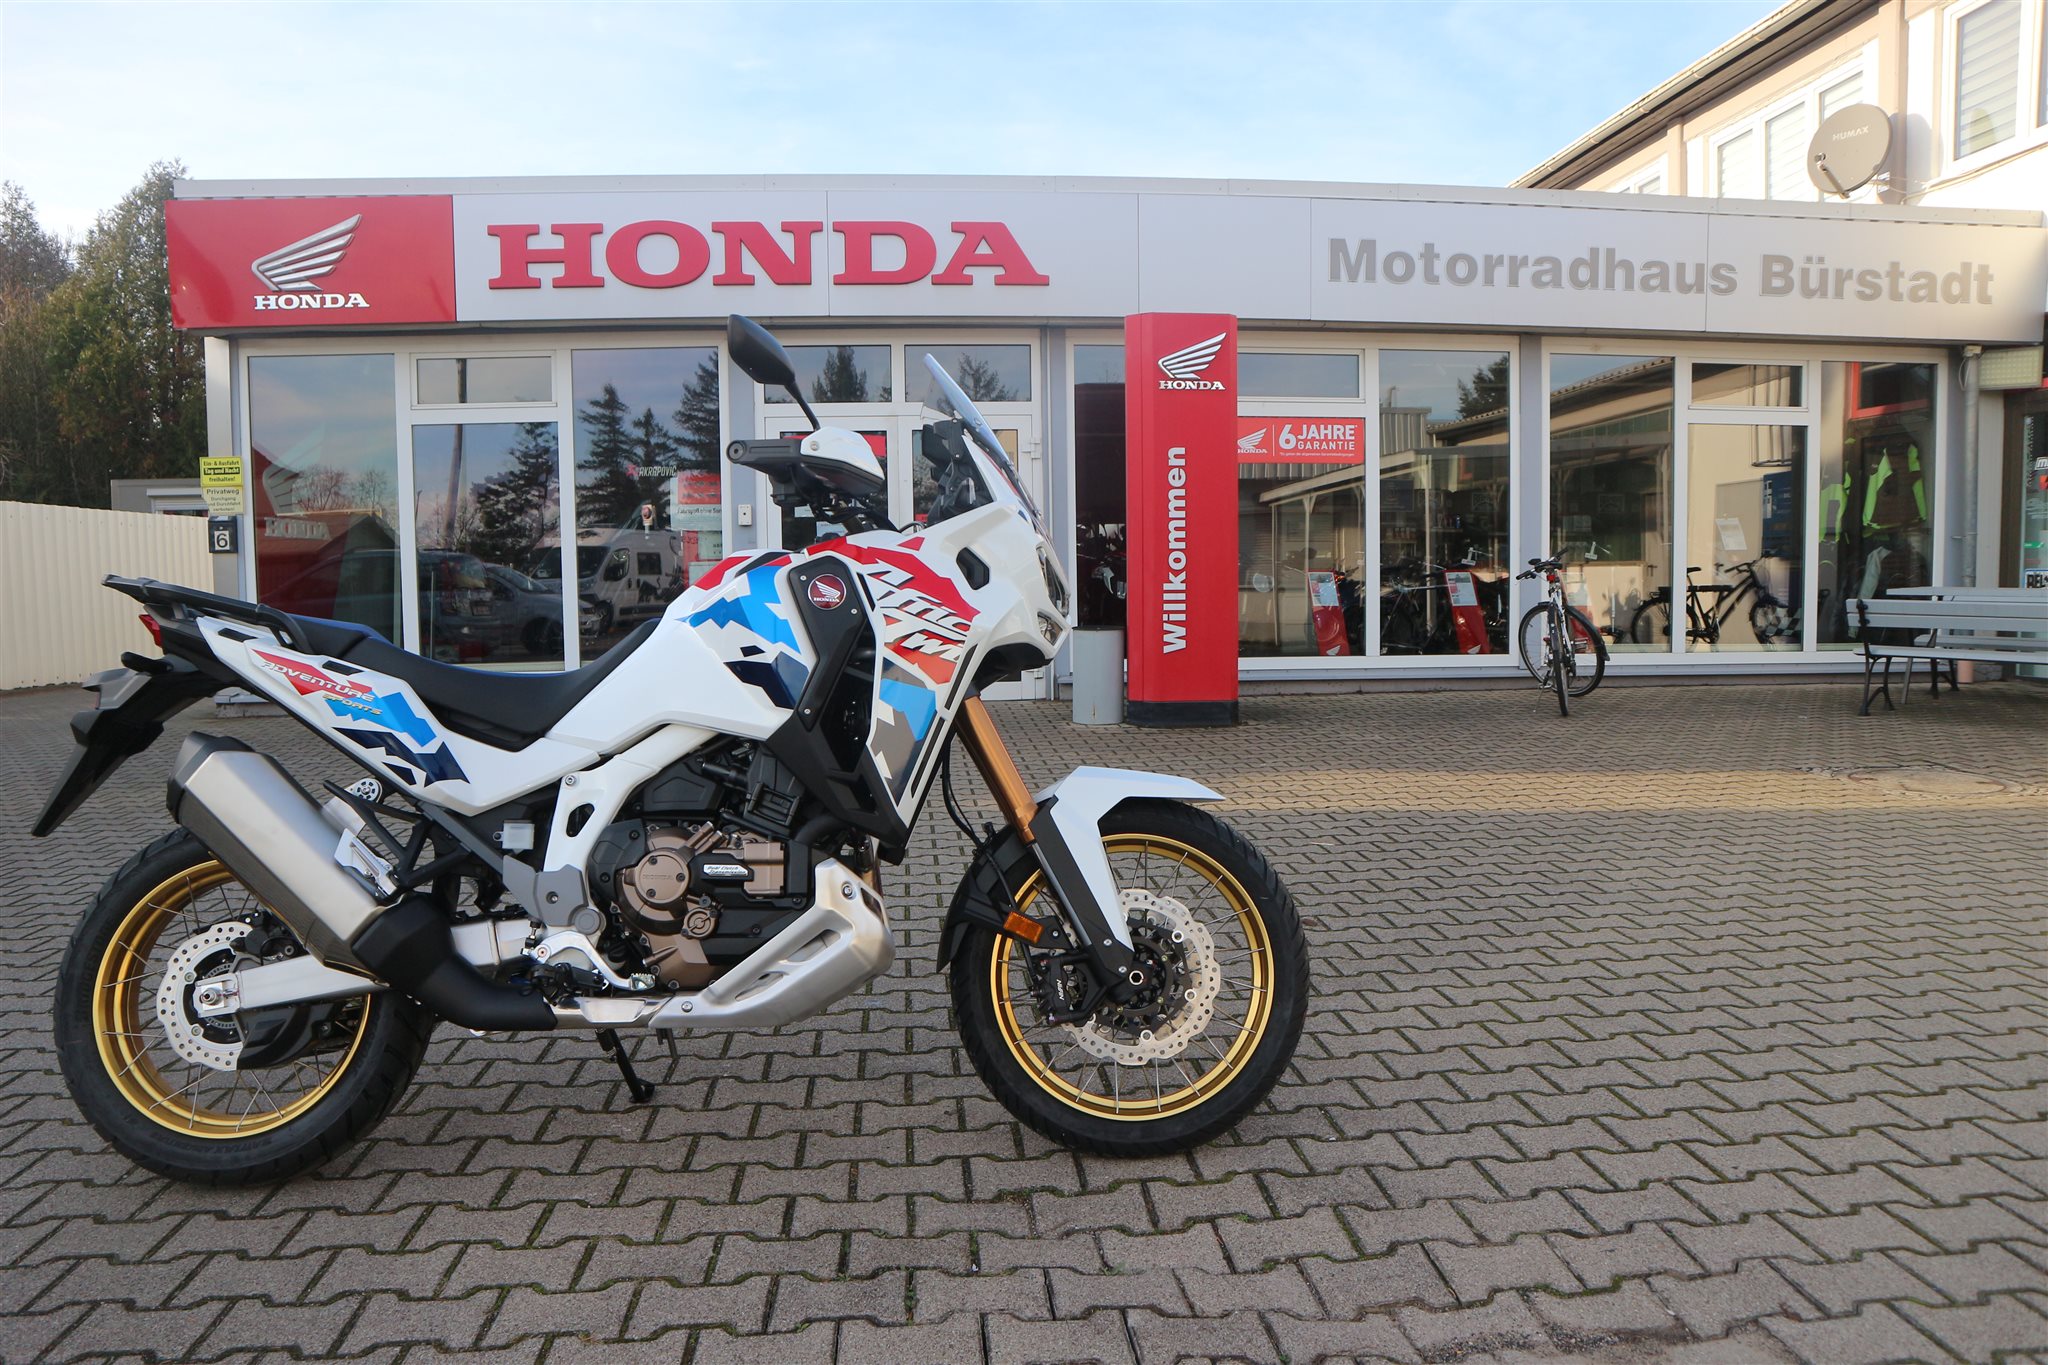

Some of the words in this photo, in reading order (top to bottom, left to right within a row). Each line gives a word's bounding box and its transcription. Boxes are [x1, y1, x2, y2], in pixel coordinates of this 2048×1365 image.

[1832, 126, 1869, 141] HUMAX
[487, 220, 1050, 289] HONDA
[1328, 237, 1739, 297] Motorradhaus
[1759, 253, 1995, 306] Bürstadt
[253, 293, 370, 310] HONDA
[1159, 380, 1226, 391] HONDA
[1278, 423, 1297, 450] 6
[1297, 441, 1355, 451] GARANTIE
[216, 533, 228, 548] 6
[1163, 447, 1187, 654] Willkommen
[261, 661, 376, 702] ADVENTURE
[322, 692, 383, 716] SPORTS
